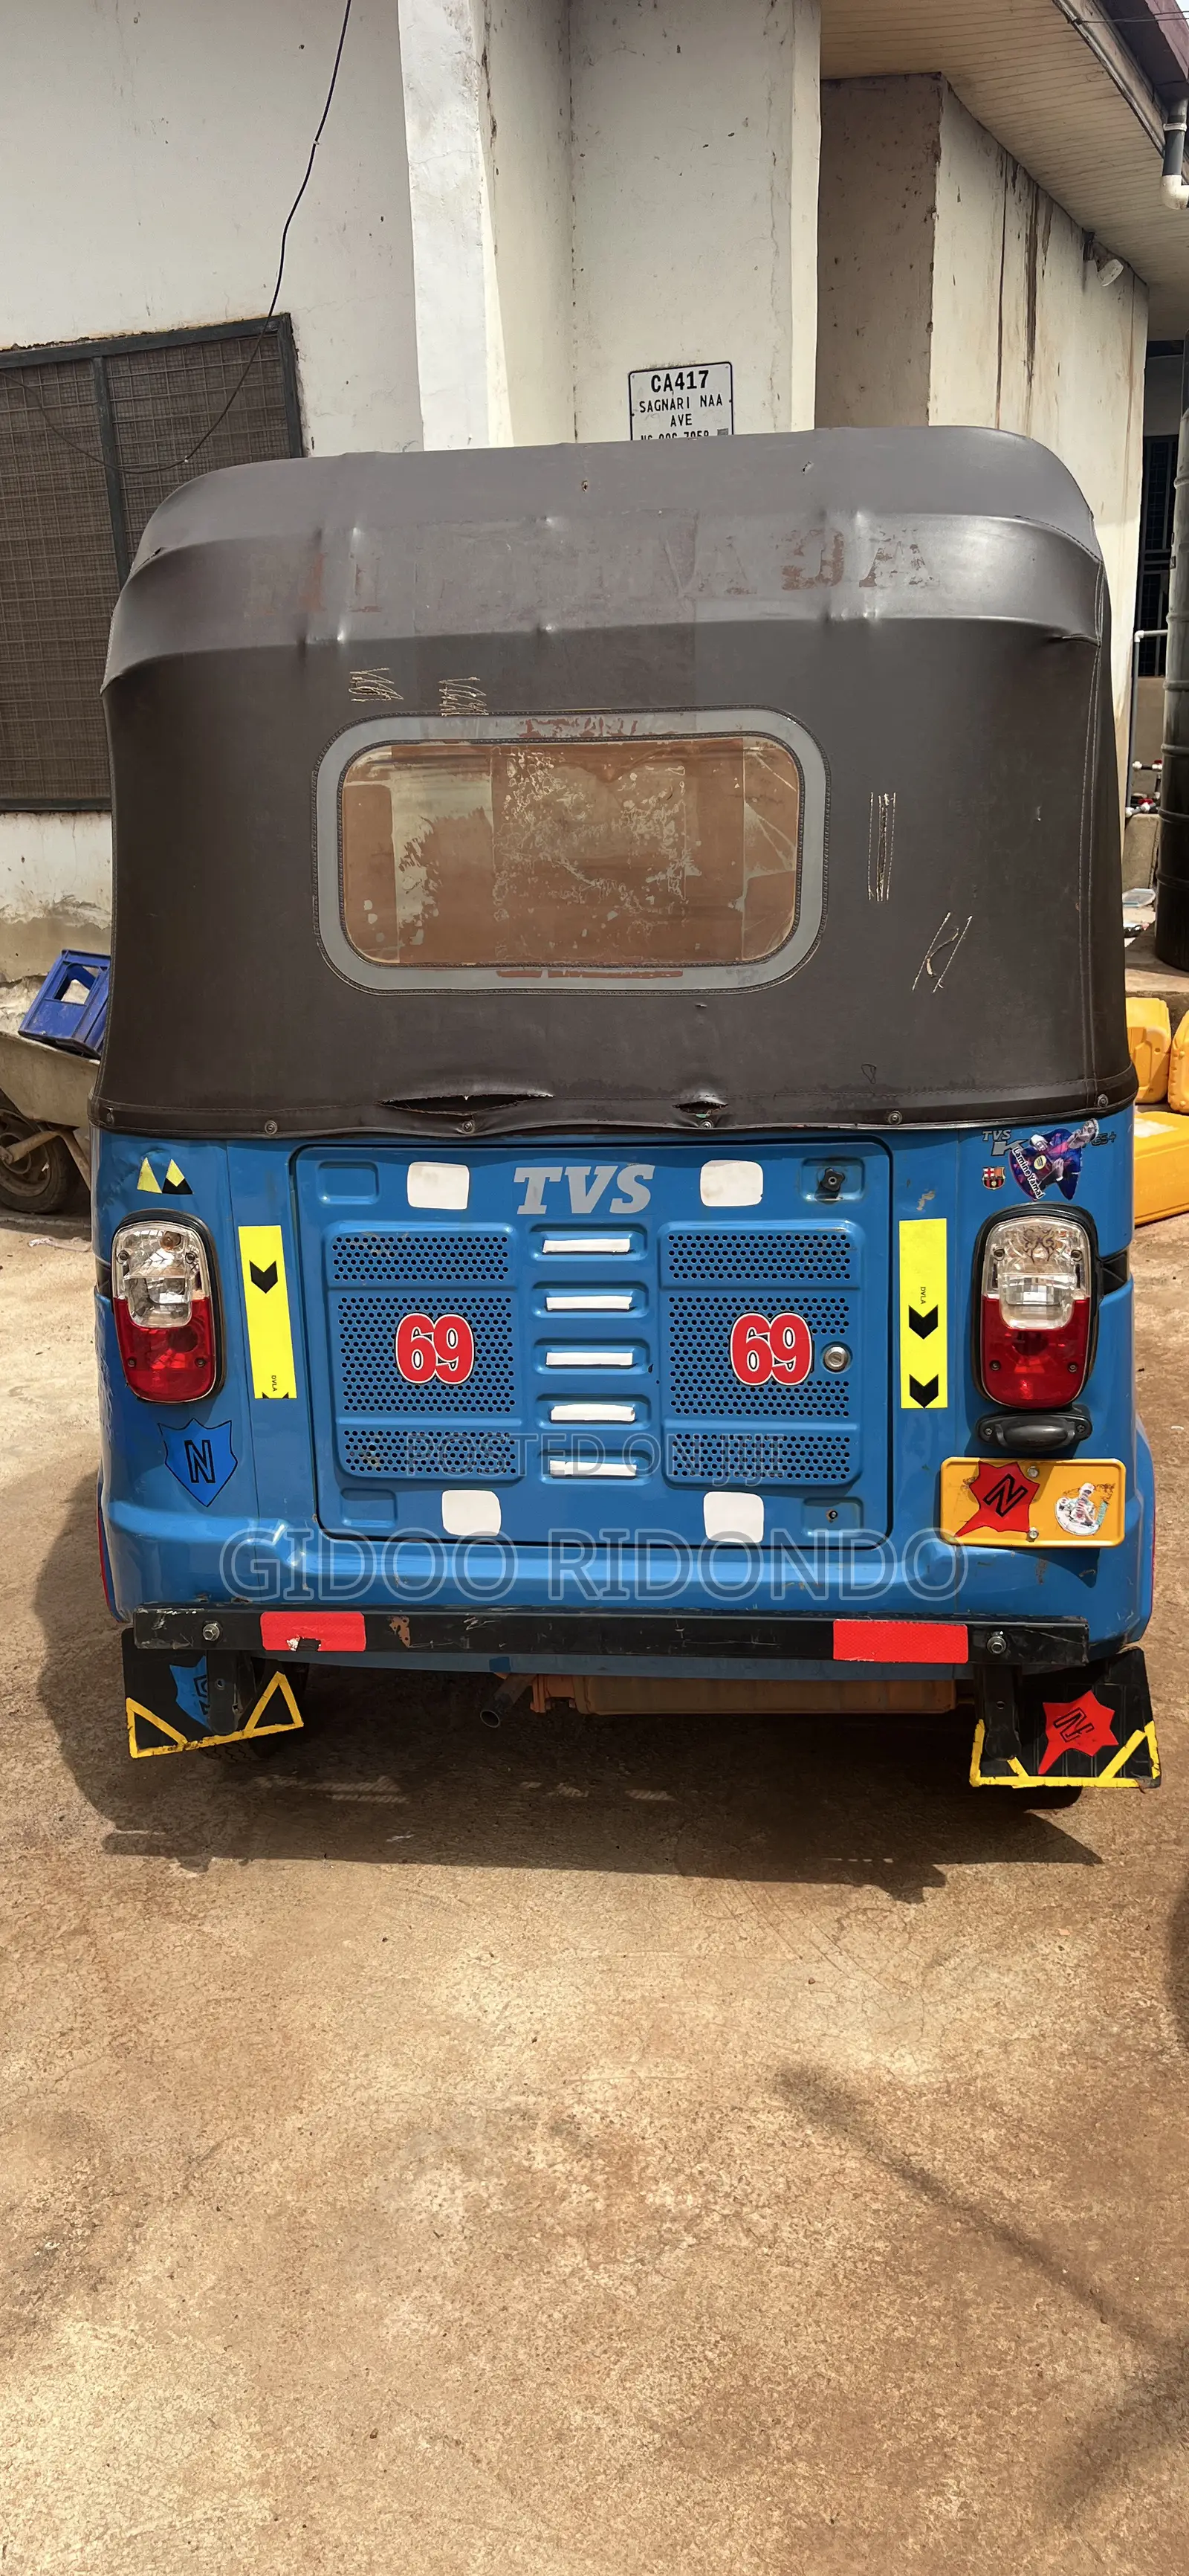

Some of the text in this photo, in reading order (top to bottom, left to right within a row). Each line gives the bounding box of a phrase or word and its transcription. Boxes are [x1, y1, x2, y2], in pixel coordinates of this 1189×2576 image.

[639, 394, 723, 413] SAGNARI NAA
[650, 370, 709, 393] CA417
[670, 413, 692, 427] AVE
[982, 1129, 1011, 1141] TVS
[513, 1164, 655, 1215] TVS
[1012, 1146, 1046, 1199] Lamine Yamal
[395, 1313, 475, 1384] 69
[730, 1312, 813, 1385] 69
[184, 1439, 216, 1484] N
[982, 1473, 1028, 1517] N
